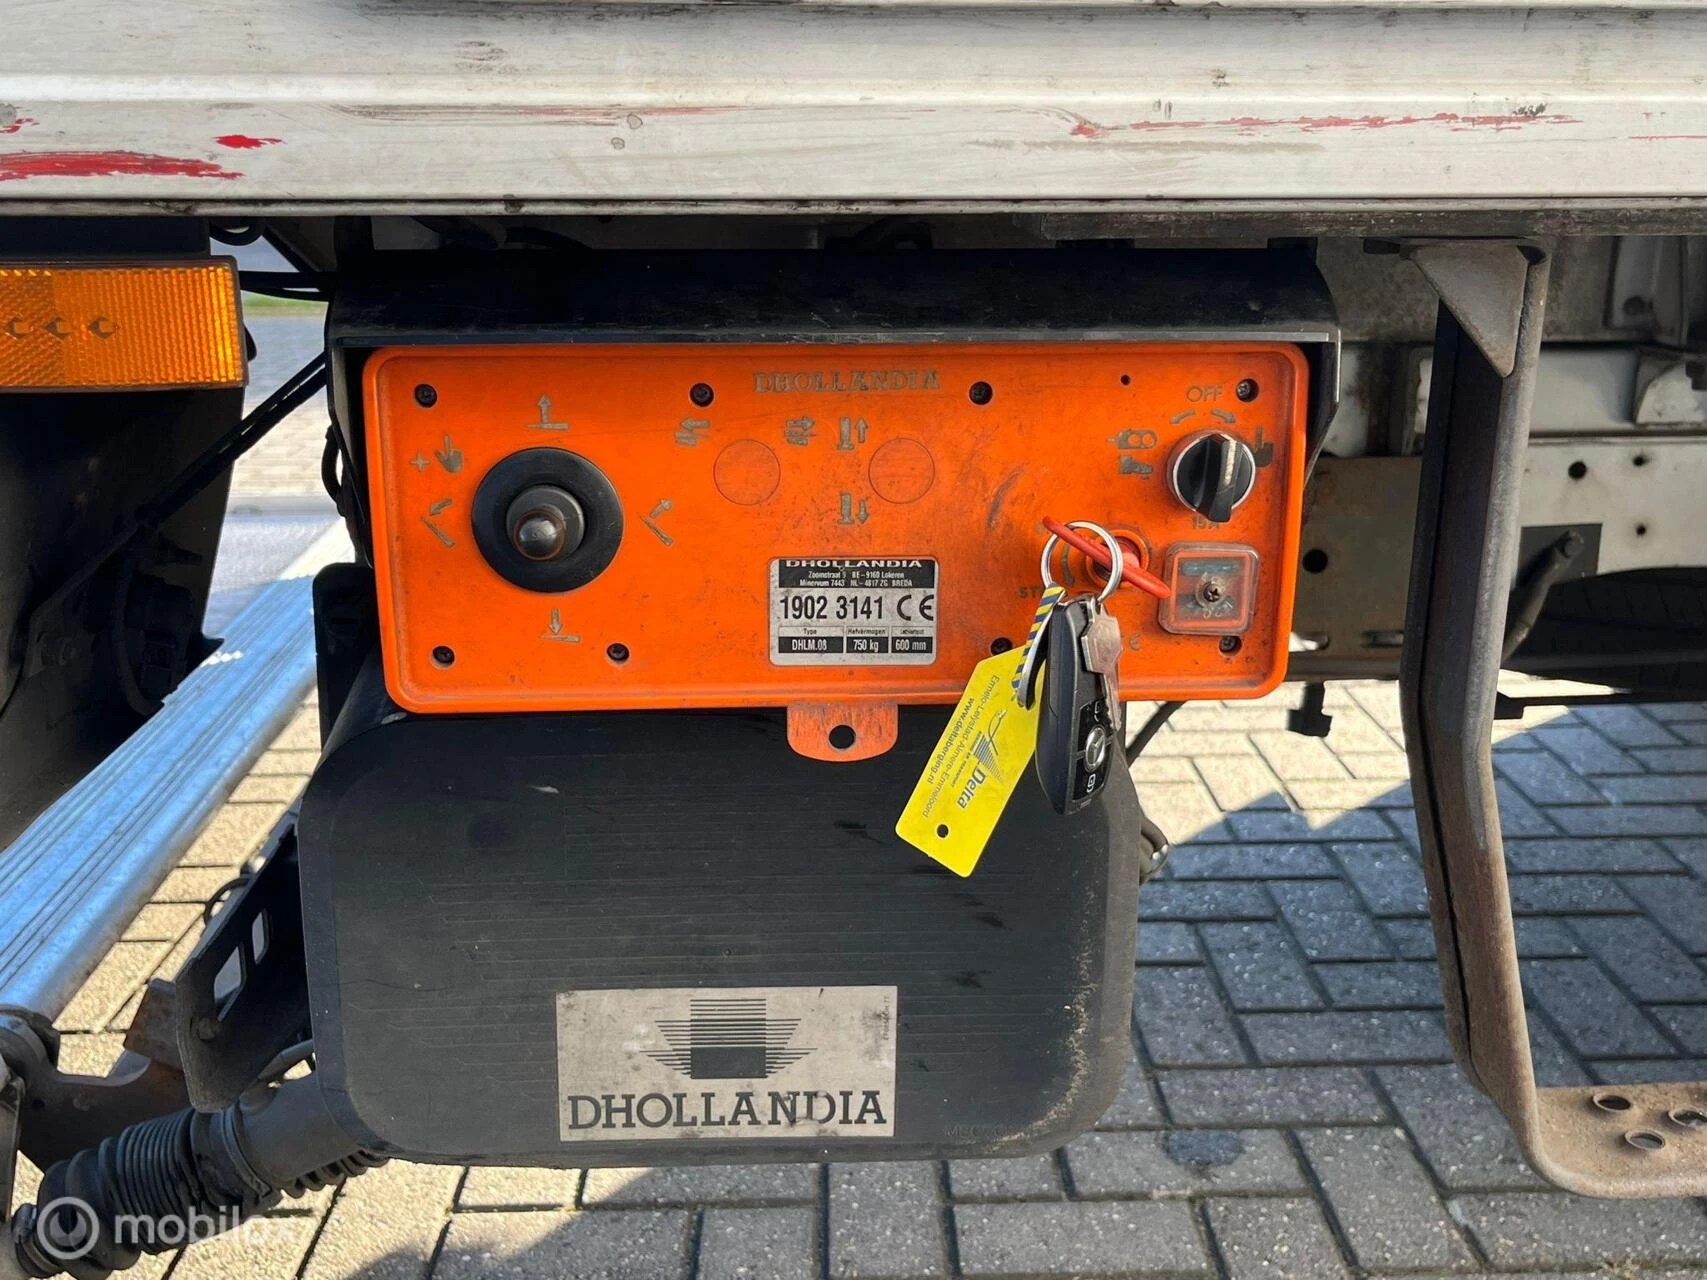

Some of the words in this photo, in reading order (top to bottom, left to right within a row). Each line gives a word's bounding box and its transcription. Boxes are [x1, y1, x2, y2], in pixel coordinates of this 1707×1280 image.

[754, 369, 940, 393] DHOLLANDIA
[1187, 386, 1222, 402] OFF
[785, 559, 922, 568] DHOLLANDIA
[892, 579, 913, 587] BREDA
[780, 595, 828, 620] 1902
[836, 595, 884, 620] 3141
[853, 639, 868, 651] 750
[869, 639, 879, 653] kg
[895, 639, 910, 650] 600
[911, 641, 927, 650] mm
[957, 768, 986, 809] Delta
[568, 1090, 887, 1129] DHOLLANDIA
